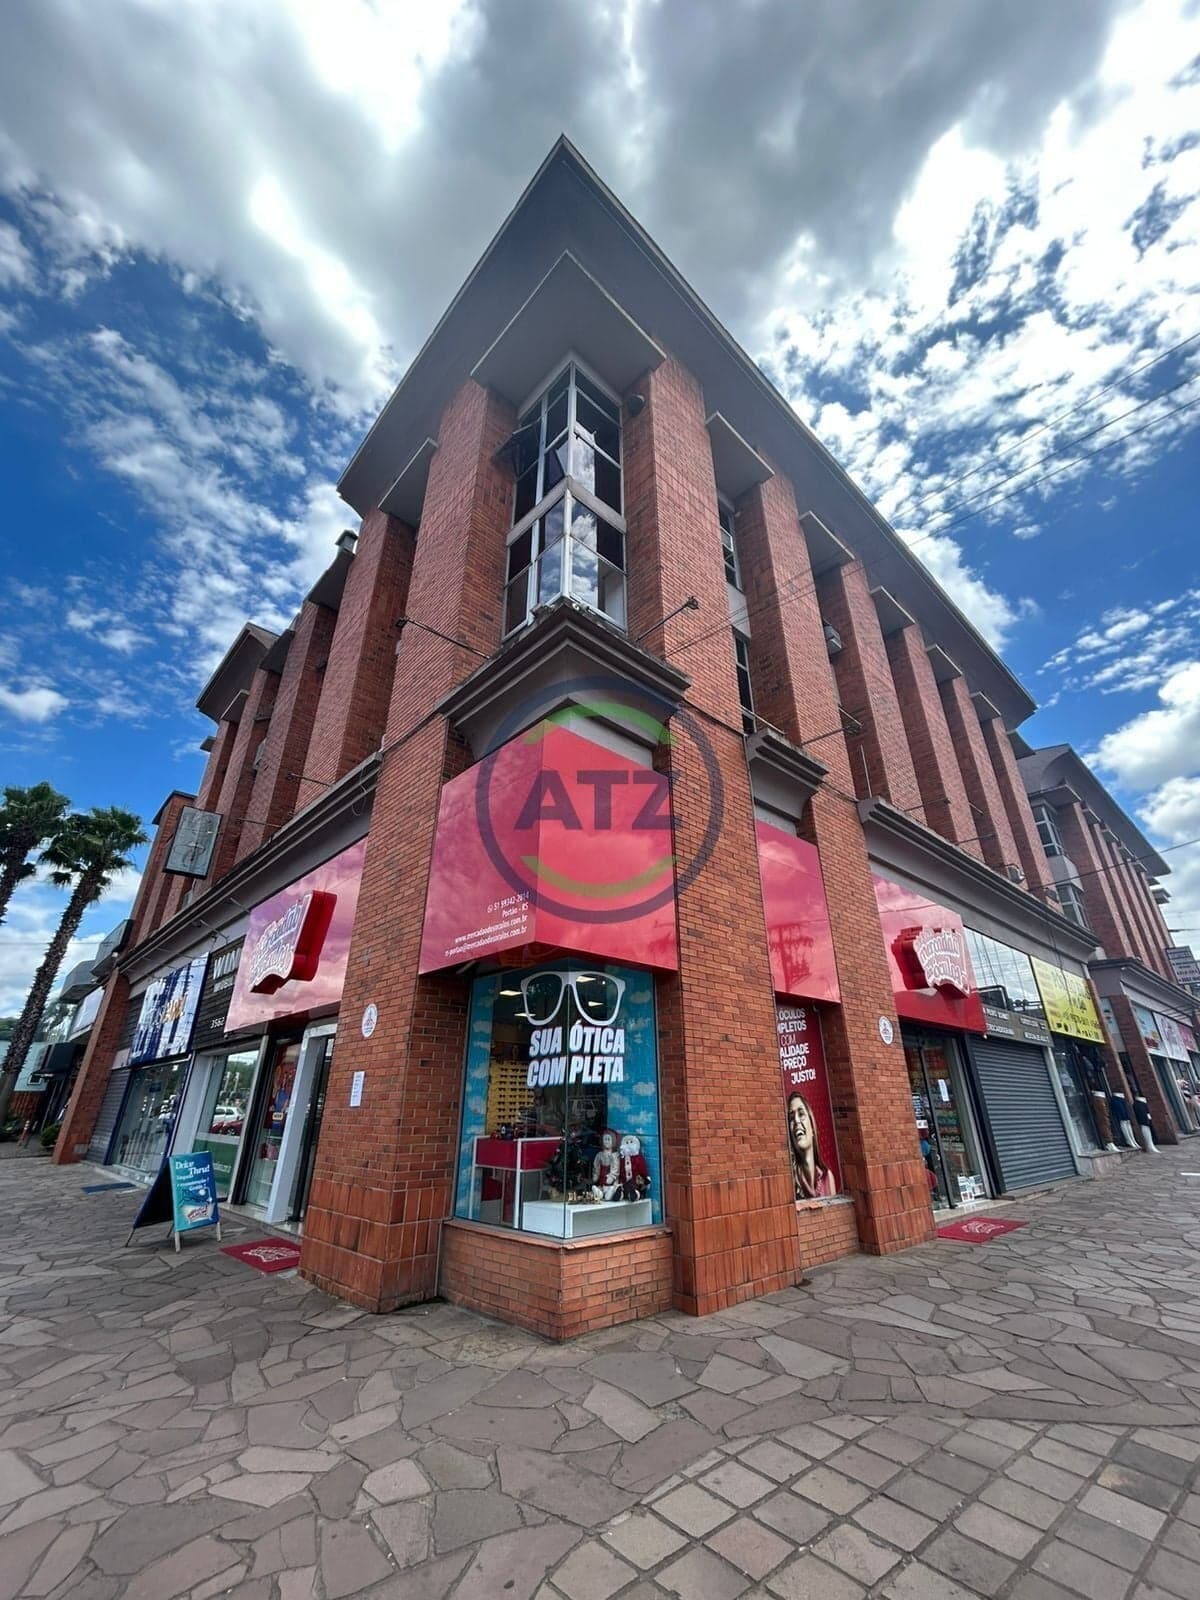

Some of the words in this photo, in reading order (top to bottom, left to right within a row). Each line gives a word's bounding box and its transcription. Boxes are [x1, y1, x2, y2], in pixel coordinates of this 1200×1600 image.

[529, 1025, 563, 1058] SUA
[569, 1019, 625, 1054] ÓTICA
[526, 1055, 624, 1088] COMPLETA
[783, 1056, 807, 1071] PREÇO
[791, 1069, 817, 1085] JUSTO!
